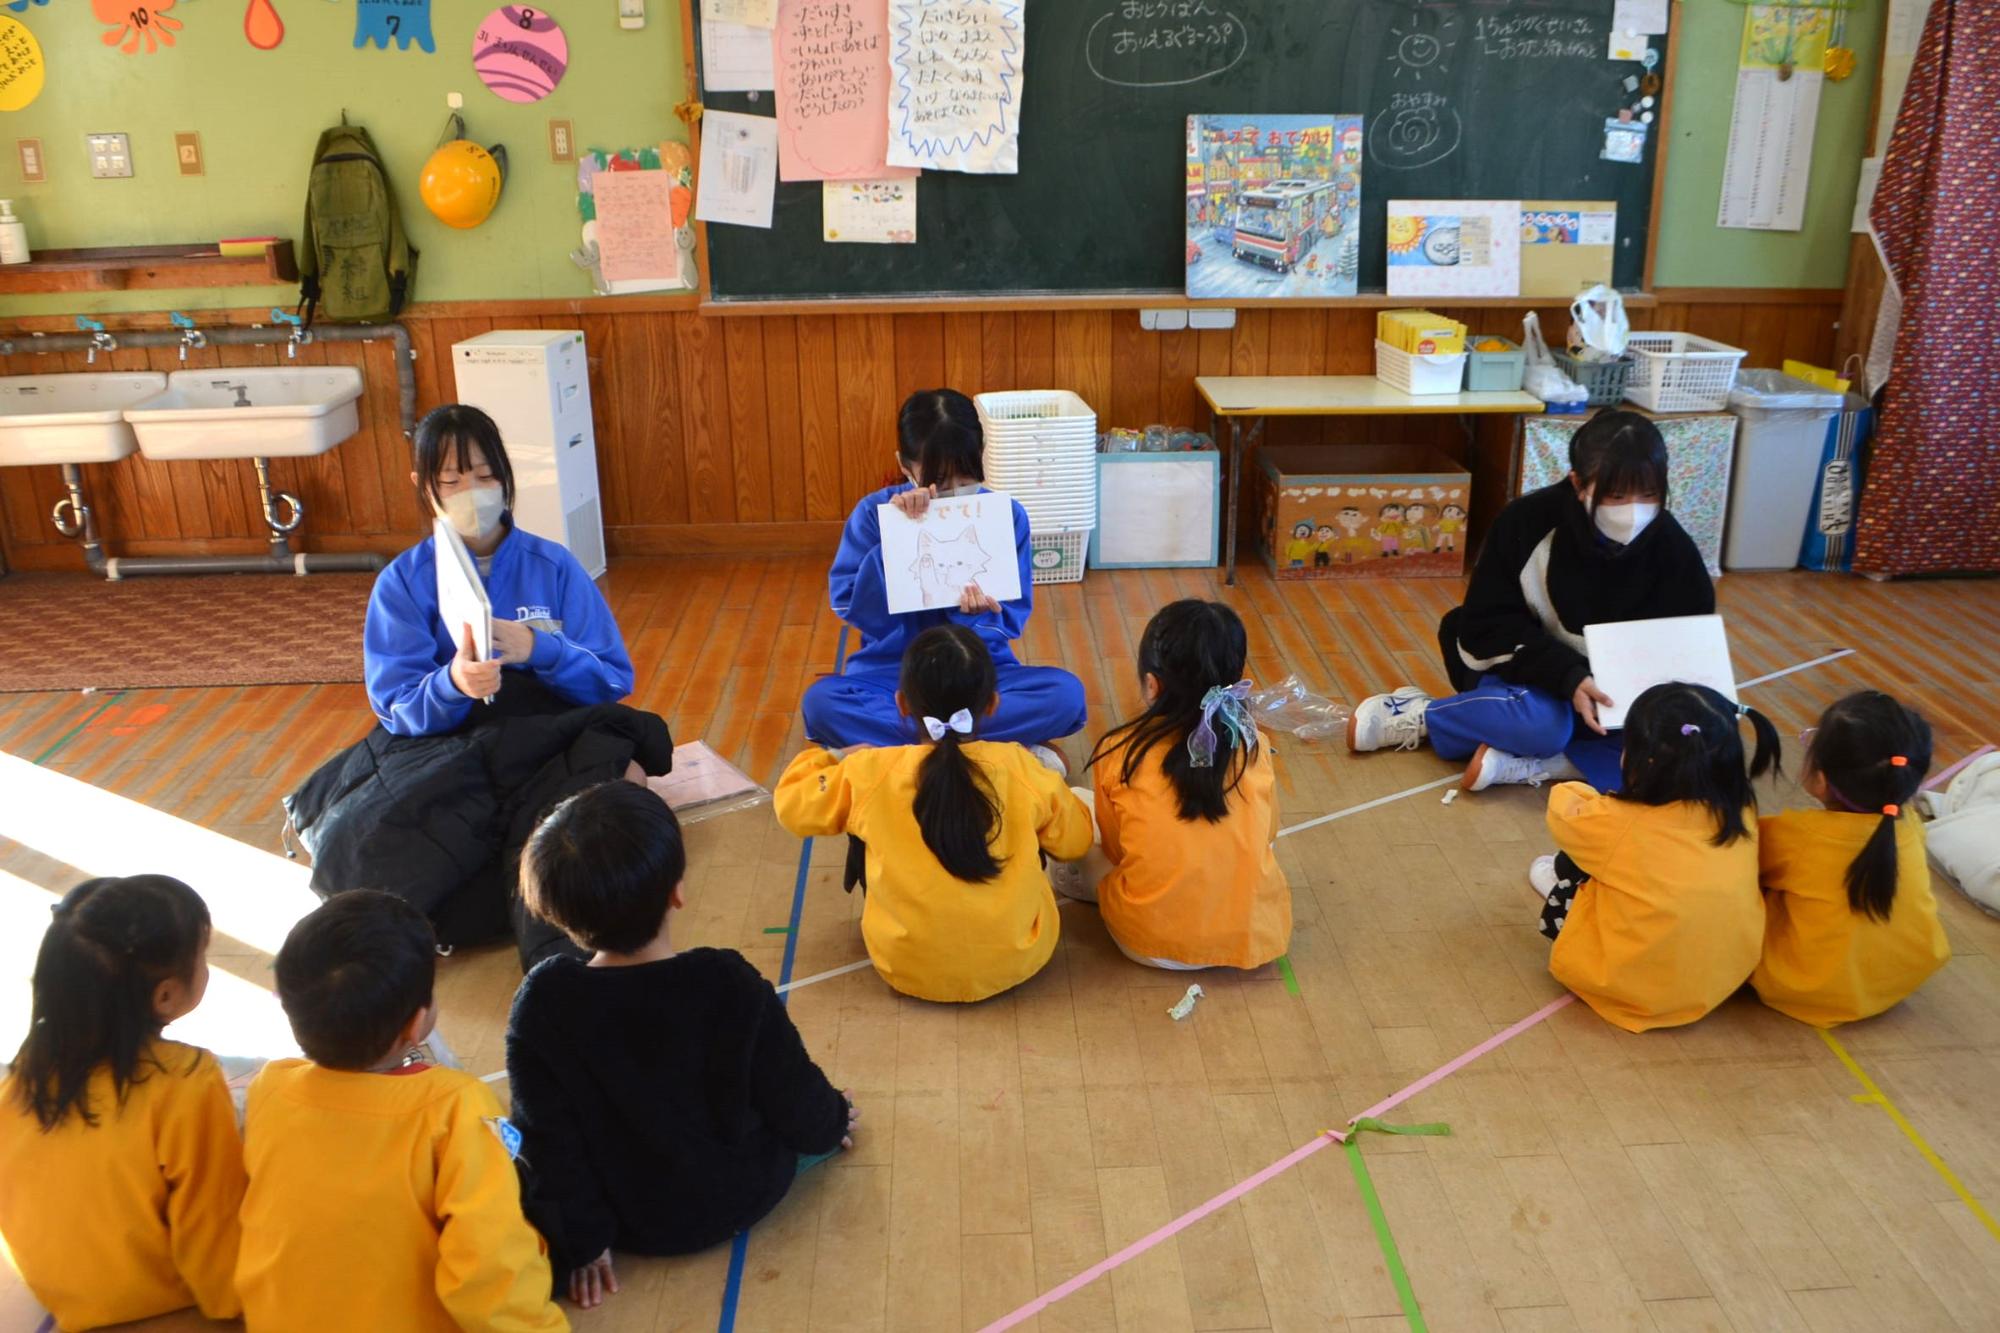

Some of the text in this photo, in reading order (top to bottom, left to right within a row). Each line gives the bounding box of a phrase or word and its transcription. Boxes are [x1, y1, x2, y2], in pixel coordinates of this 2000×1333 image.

[130, 7, 148, 28] 10
[386, 15, 400, 35] 7
[519, 9, 533, 29] 8
